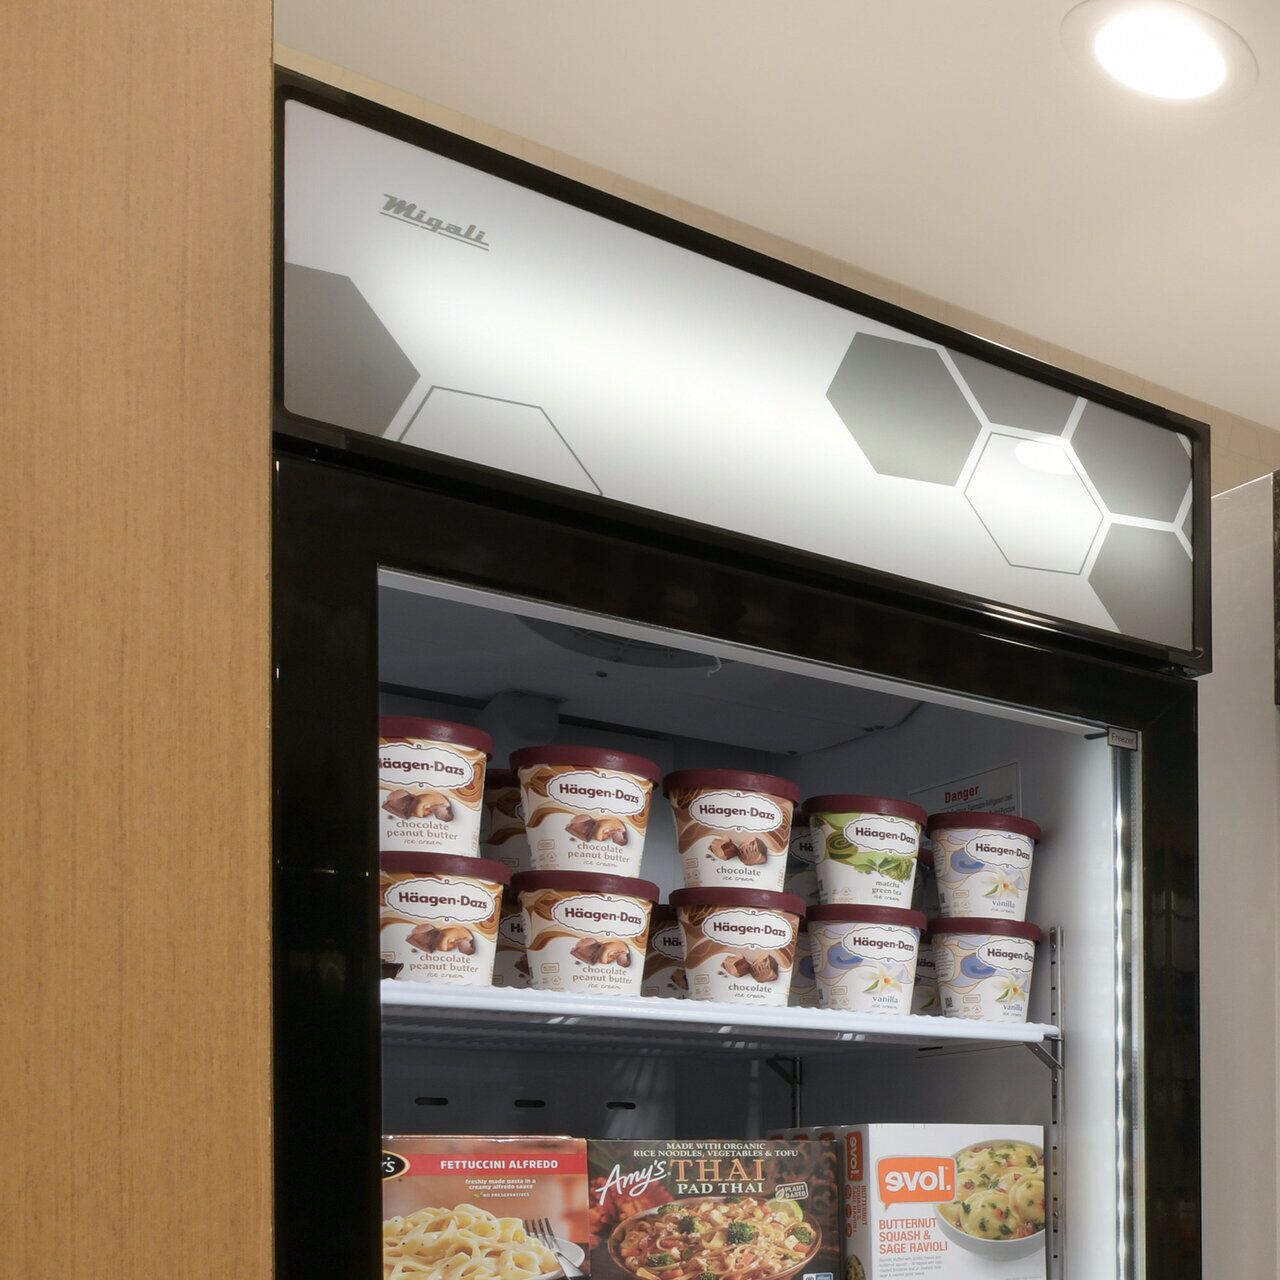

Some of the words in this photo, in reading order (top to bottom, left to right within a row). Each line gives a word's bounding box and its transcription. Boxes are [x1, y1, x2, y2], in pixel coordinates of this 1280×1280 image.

[380, 193, 489, 248] Migali
[559, 783, 639, 803] Häagen-Dazs
[945, 785, 979, 802] Danger
[699, 804, 775, 821] Häagen-Dazs
[397, 820, 449, 830] chocolate
[387, 829, 423, 839] peanut
[426, 831, 458, 839] butter
[577, 842, 623, 854] chocolate
[567, 850, 601, 861] peanut
[602, 853, 629, 863] butter
[717, 866, 761, 876] chocolate
[398, 891, 488, 909] Häagen-Dazs
[992, 900, 1015, 909] vanilla
[564, 906, 642, 925] Häagen-Dazs
[713, 922, 786, 937] Häagen-Dazs
[419, 954, 471, 964] chocolate
[410, 961, 445, 972] peanut
[447, 964, 478, 973] butter
[728, 983, 772, 993] chocolate
[872, 995, 898, 1003] vanilla
[697, 1142, 721, 1151] WITH
[441, 1160, 505, 1169] FETTUCCINI
[509, 1160, 558, 1169] ALFREDO
[670, 1160, 765, 1181] THAI
[596, 1161, 667, 1204] Amy's
[678, 1184, 713, 1193] PAD
[718, 1183, 764, 1193] THAI
[879, 1218, 937, 1229] BUTTERNUT
[879, 1231, 921, 1241] SQUASH
[924, 1231, 931, 1240] &
[880, 1243, 906, 1254] SAGE
[910, 1241, 948, 1252] RAVIOLI
